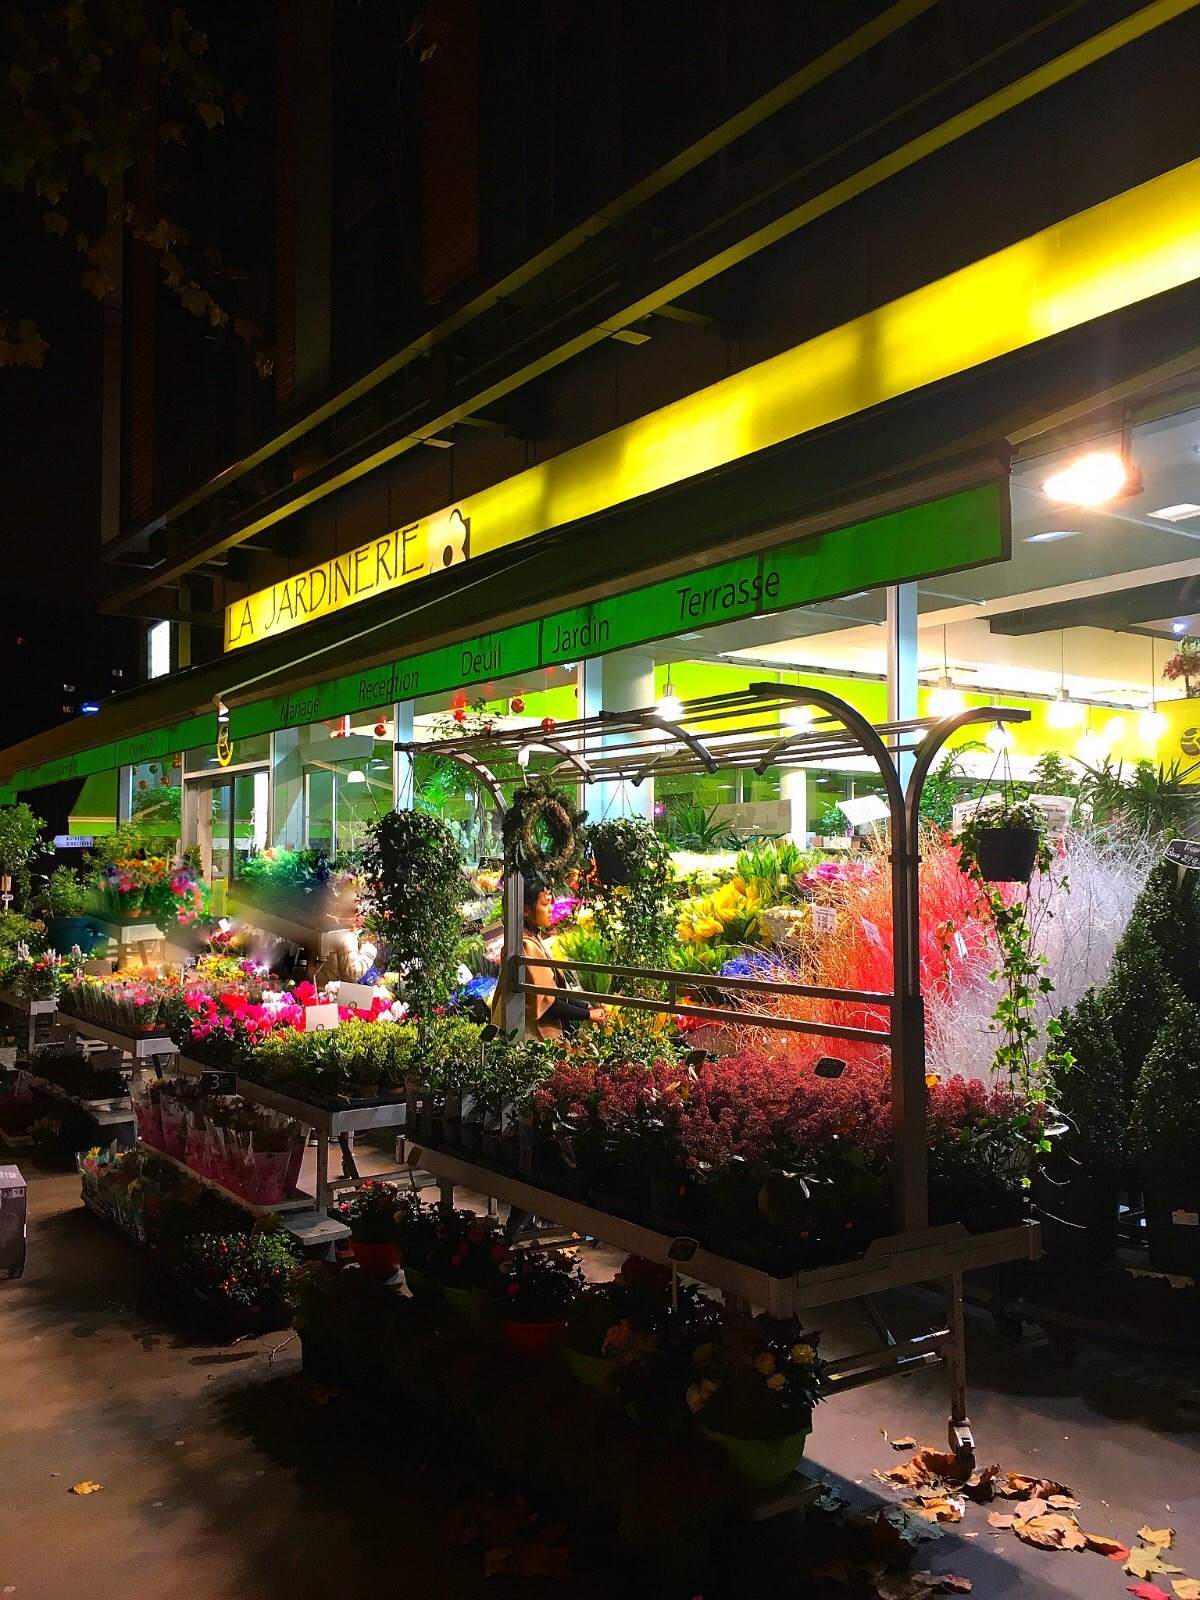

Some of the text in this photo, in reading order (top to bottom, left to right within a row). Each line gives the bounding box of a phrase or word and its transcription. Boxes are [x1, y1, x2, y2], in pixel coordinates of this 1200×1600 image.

[227, 523, 424, 644] LA JARDINERIE
[279, 571, 780, 722] Mariage Réception Deuil Jardin Terrasse
